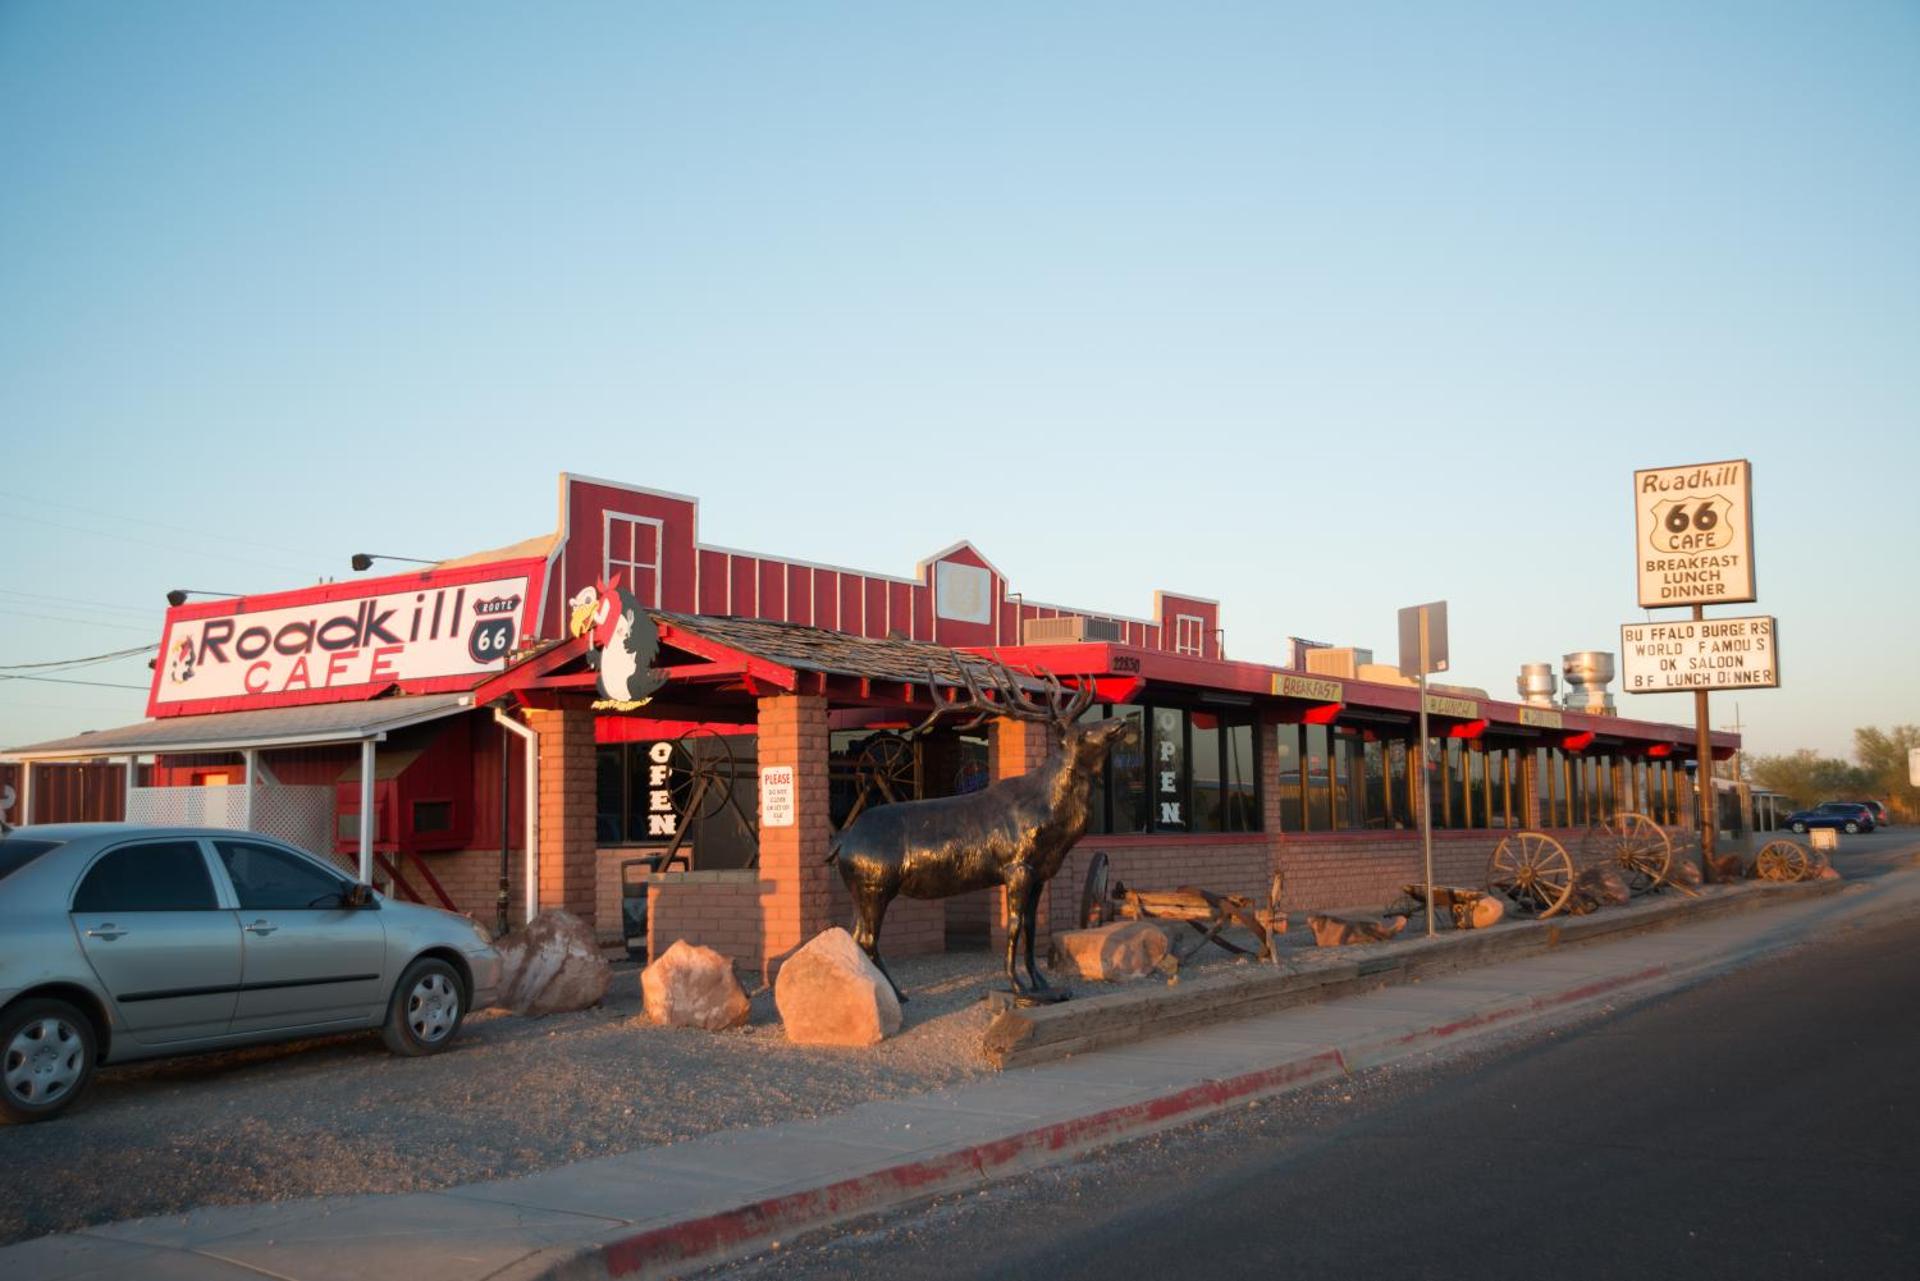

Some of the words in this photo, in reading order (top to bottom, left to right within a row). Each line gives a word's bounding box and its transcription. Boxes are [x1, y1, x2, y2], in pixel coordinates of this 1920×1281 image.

[1642, 466, 1738, 493] Roadkill
[1665, 501, 1718, 533] 66
[1669, 532, 1716, 549] CAFE
[1646, 555, 1738, 572] BREAKFAST
[1663, 571, 1721, 584] LUNCH
[1661, 583, 1726, 599] DINNER
[482, 600, 513, 613] ROUTE
[197, 587, 466, 667] Roadkill
[478, 627, 506, 651] 66
[1636, 643, 1683, 656] WORLD
[243, 645, 406, 695] CAFE
[1660, 658, 1677, 671] OK
[1690, 655, 1744, 669] SALOON
[1666, 672, 1711, 686] LUNCH
[1717, 669, 1772, 684] DINNER
[1283, 676, 1340, 700] BREAKFAST
[1160, 712, 1180, 824] OPEN
[764, 773, 790, 785] PLEASE
